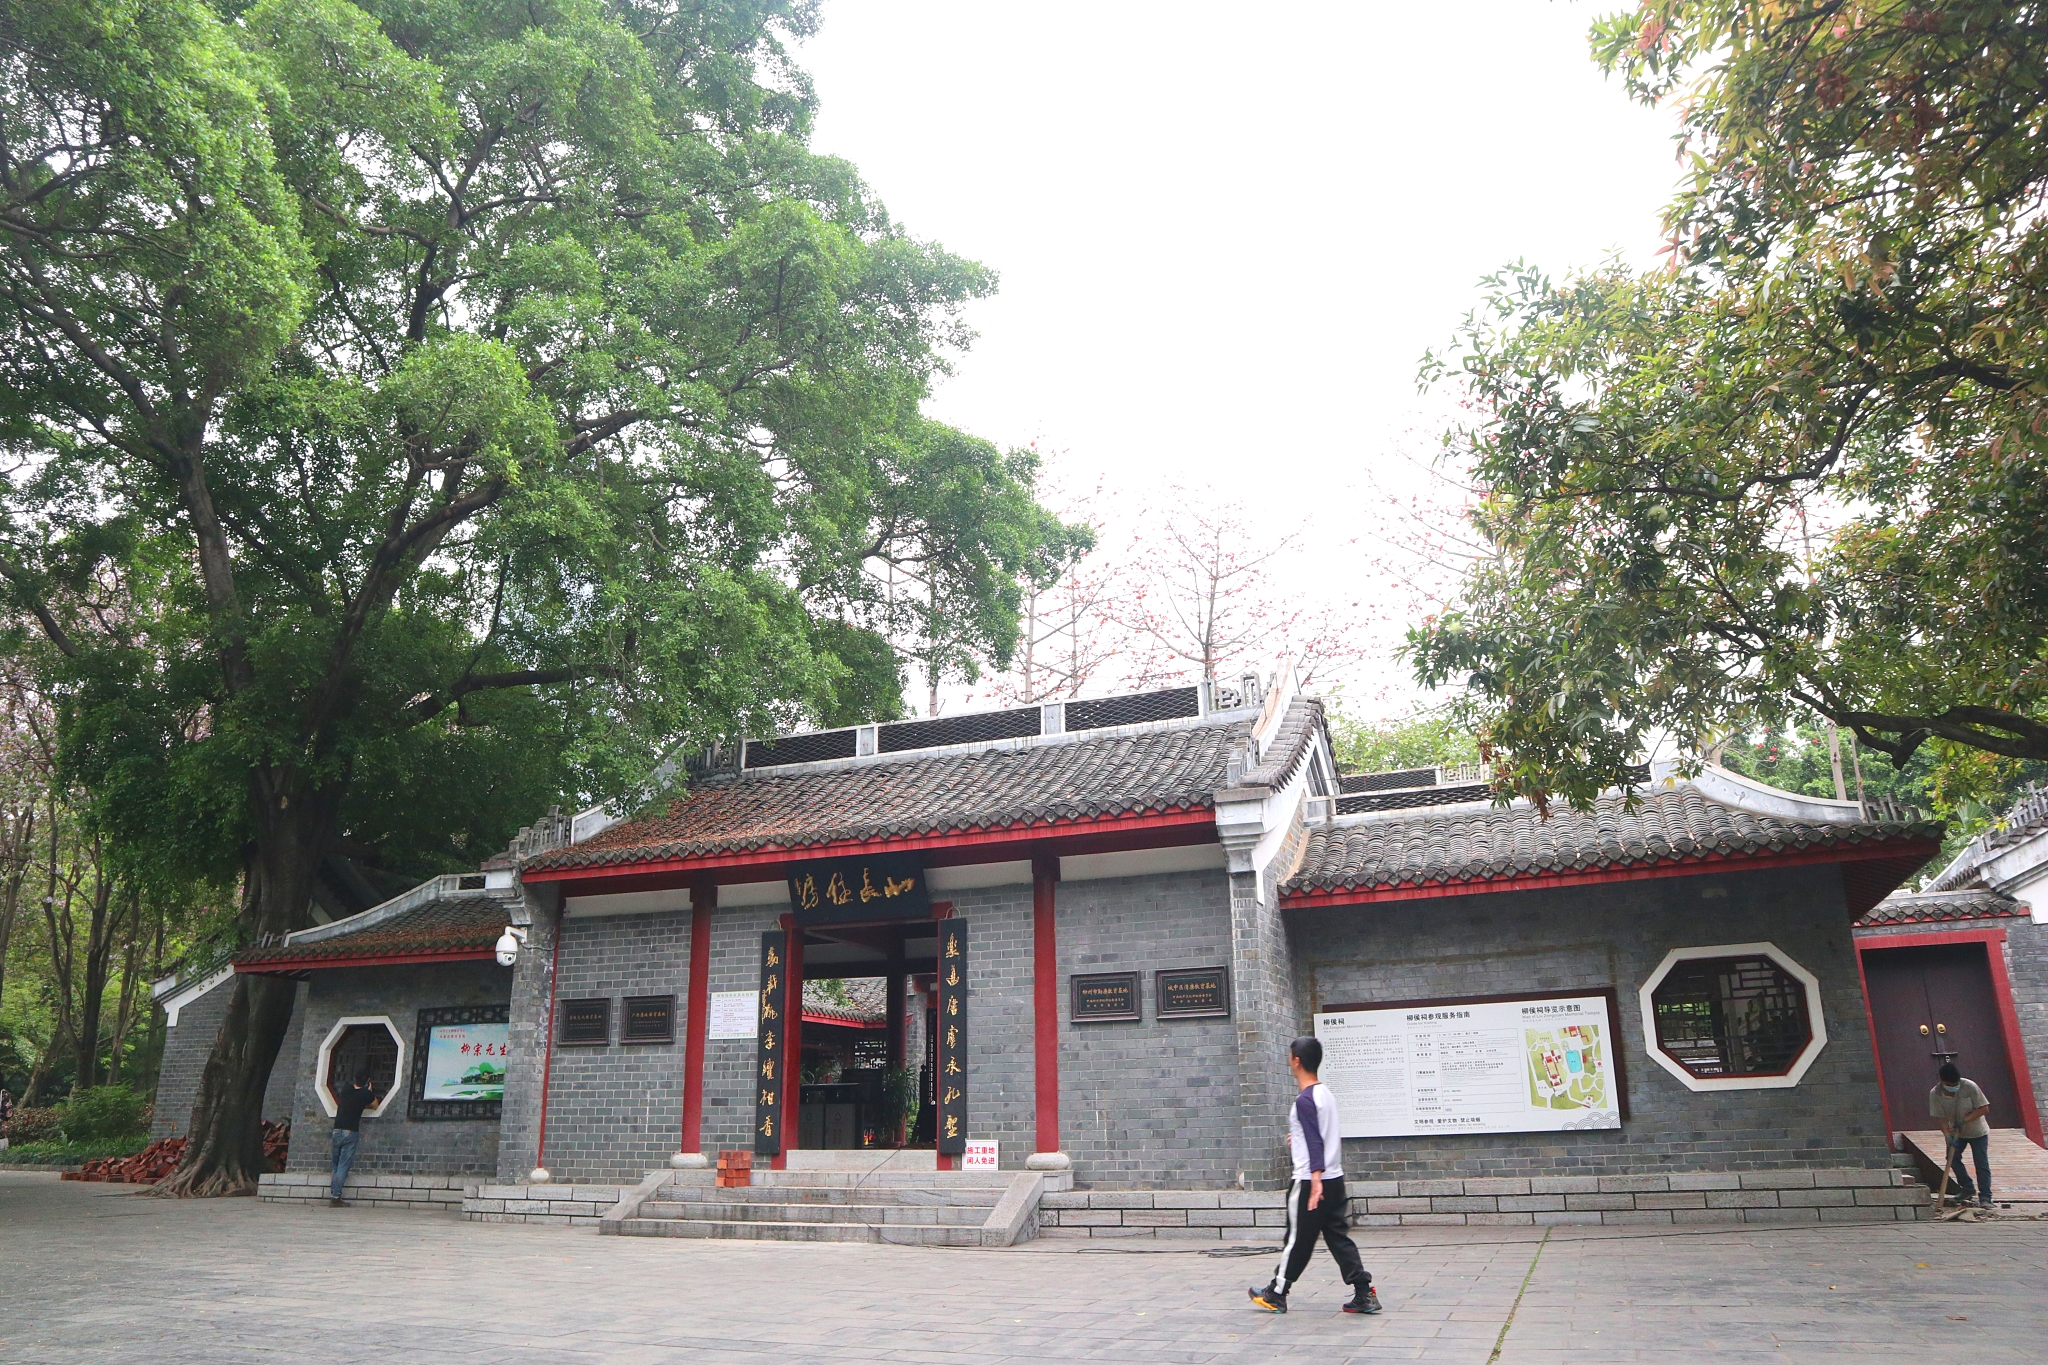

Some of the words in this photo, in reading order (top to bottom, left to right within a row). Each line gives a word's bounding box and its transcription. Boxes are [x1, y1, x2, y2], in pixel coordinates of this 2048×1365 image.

[1521, 1004, 1581, 1014] 柳侯祠导览示意图
[1407, 1011, 1470, 1021] 柳侯祠参观服务指南
[1323, 1018, 1345, 1026] 柳侯祠
[461, 1043, 507, 1056] 柳宗元生
